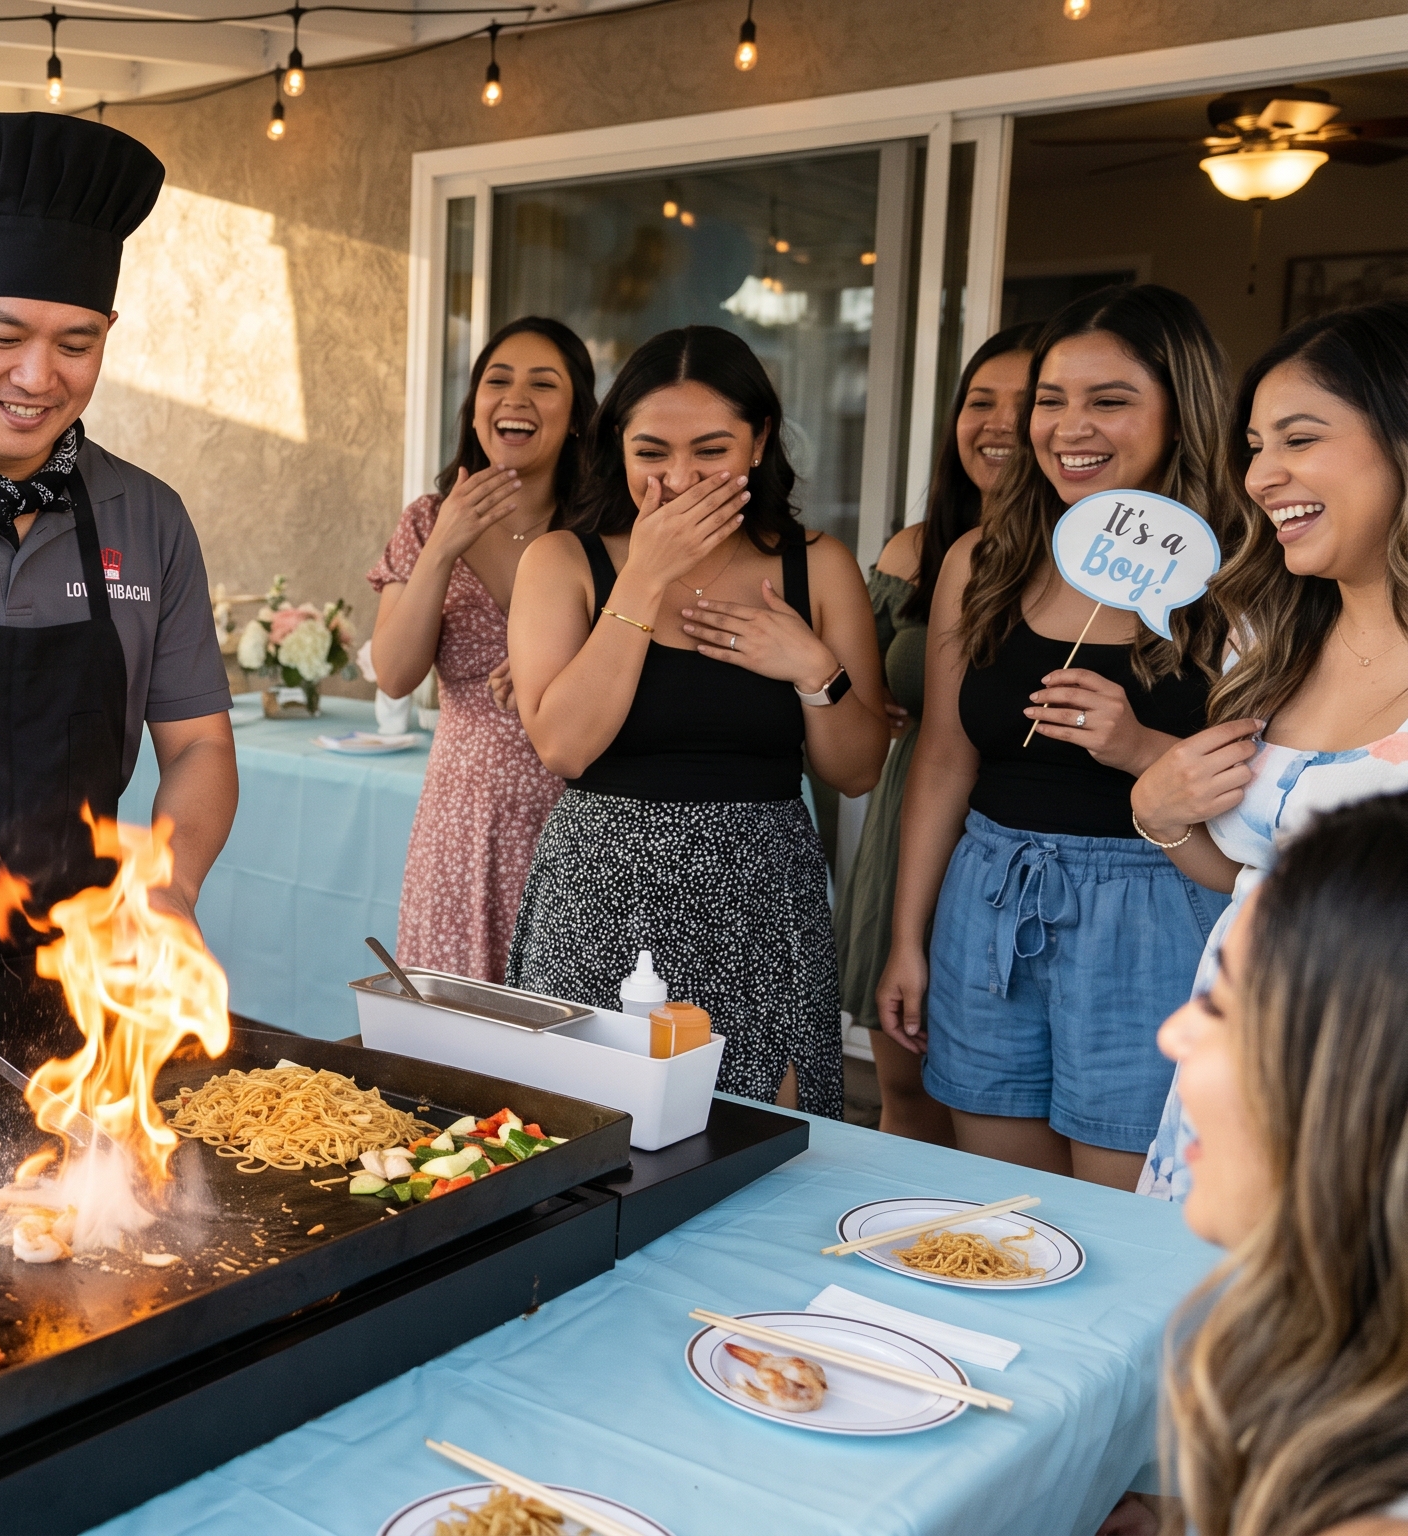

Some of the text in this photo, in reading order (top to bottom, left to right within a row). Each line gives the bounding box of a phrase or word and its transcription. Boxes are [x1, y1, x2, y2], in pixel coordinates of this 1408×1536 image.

[1102, 501, 1187, 556] It's a
[106, 583, 151, 602] HIBACHI
[1080, 533, 1178, 602] Boy!
